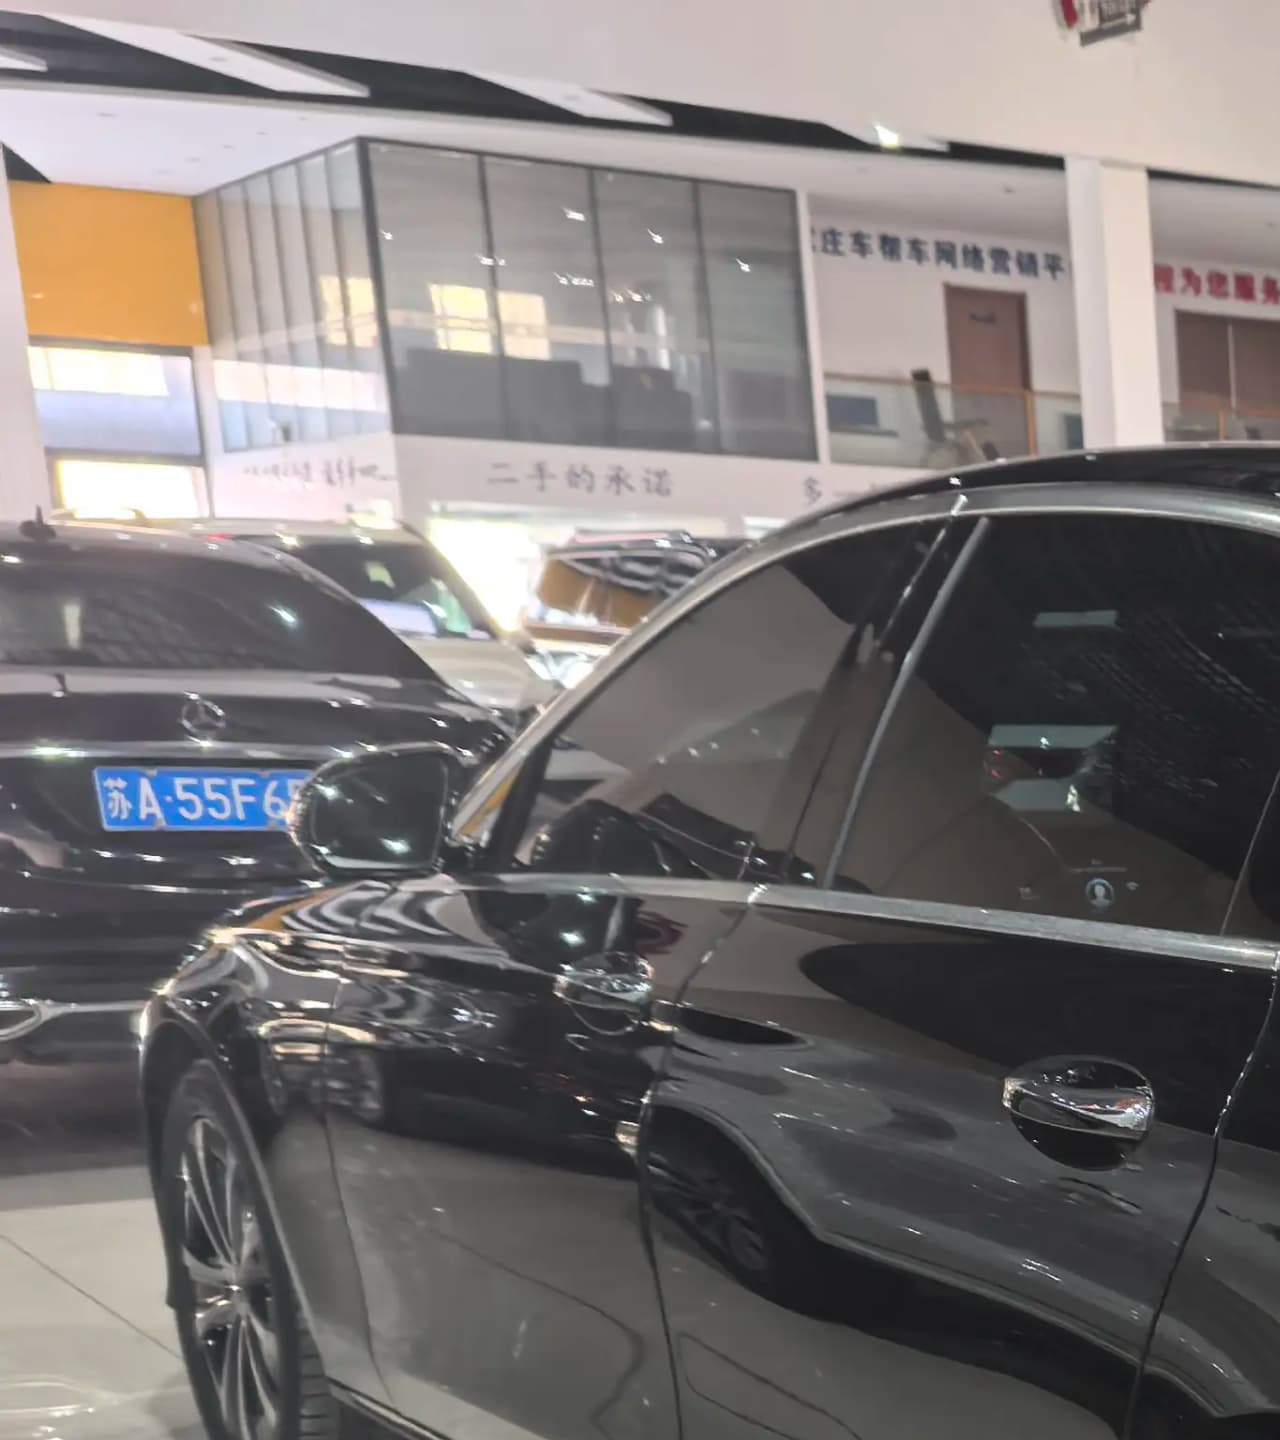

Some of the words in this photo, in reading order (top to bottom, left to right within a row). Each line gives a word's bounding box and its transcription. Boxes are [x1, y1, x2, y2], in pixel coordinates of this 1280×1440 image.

[811, 226, 1065, 280] 庄车帮车网络营销平
